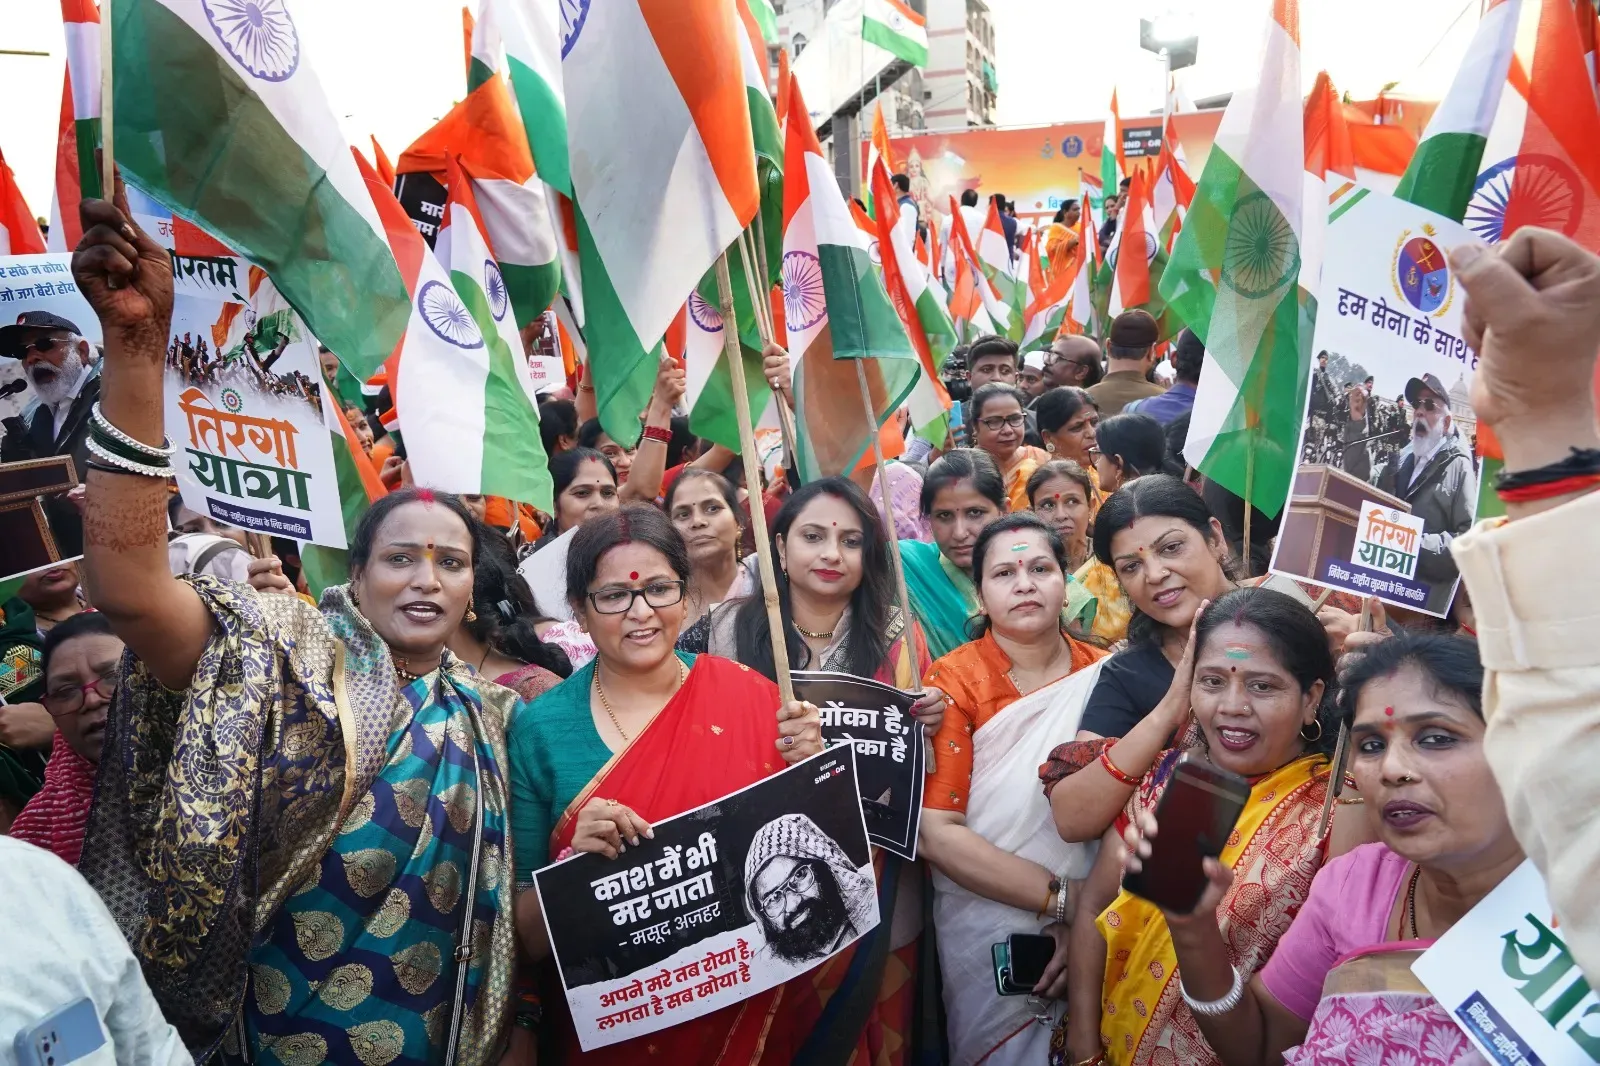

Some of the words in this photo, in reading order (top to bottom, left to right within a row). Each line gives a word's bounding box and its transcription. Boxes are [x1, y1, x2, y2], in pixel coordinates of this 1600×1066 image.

[6, 263, 29, 277] सके
[29, 265, 41, 275] न
[0, 287, 15, 301] जो
[15, 287, 35, 300] जग
[34, 282, 56, 297] बैरी
[55, 281, 76, 295] होय
[1338, 288, 1368, 320] हम
[1372, 297, 1410, 338] सेना
[1414, 315, 1432, 345] के
[1434, 328, 1468, 364] साथ
[185, 447, 312, 511] यात्रा
[1328, 564, 1350, 581] निवेदक
[1370, 577, 1388, 592] सुरक्षा
[1358, 540, 1416, 576] यात्रा
[883, 704, 909, 735] है,
[890, 735, 907, 763] है
[590, 862, 655, 901] काश
[685, 832, 718, 870] भी
[608, 894, 652, 925] मर
[652, 870, 714, 910] जाता
[630, 920, 671, 945] मसूद
[674, 901, 720, 930] अज़हर
[600, 979, 644, 1008] अपने
[645, 969, 672, 992] मरे
[673, 961, 700, 982] तब
[701, 947, 737, 973] रोया
[736, 938, 755, 960] है,
[596, 1003, 650, 1030] लगता
[651, 995, 664, 1016] है
[664, 987, 693, 1009] सब
[694, 970, 737, 998] खोया
[738, 962, 751, 983] है
[1466, 1001, 1497, 1034] निवेदक
